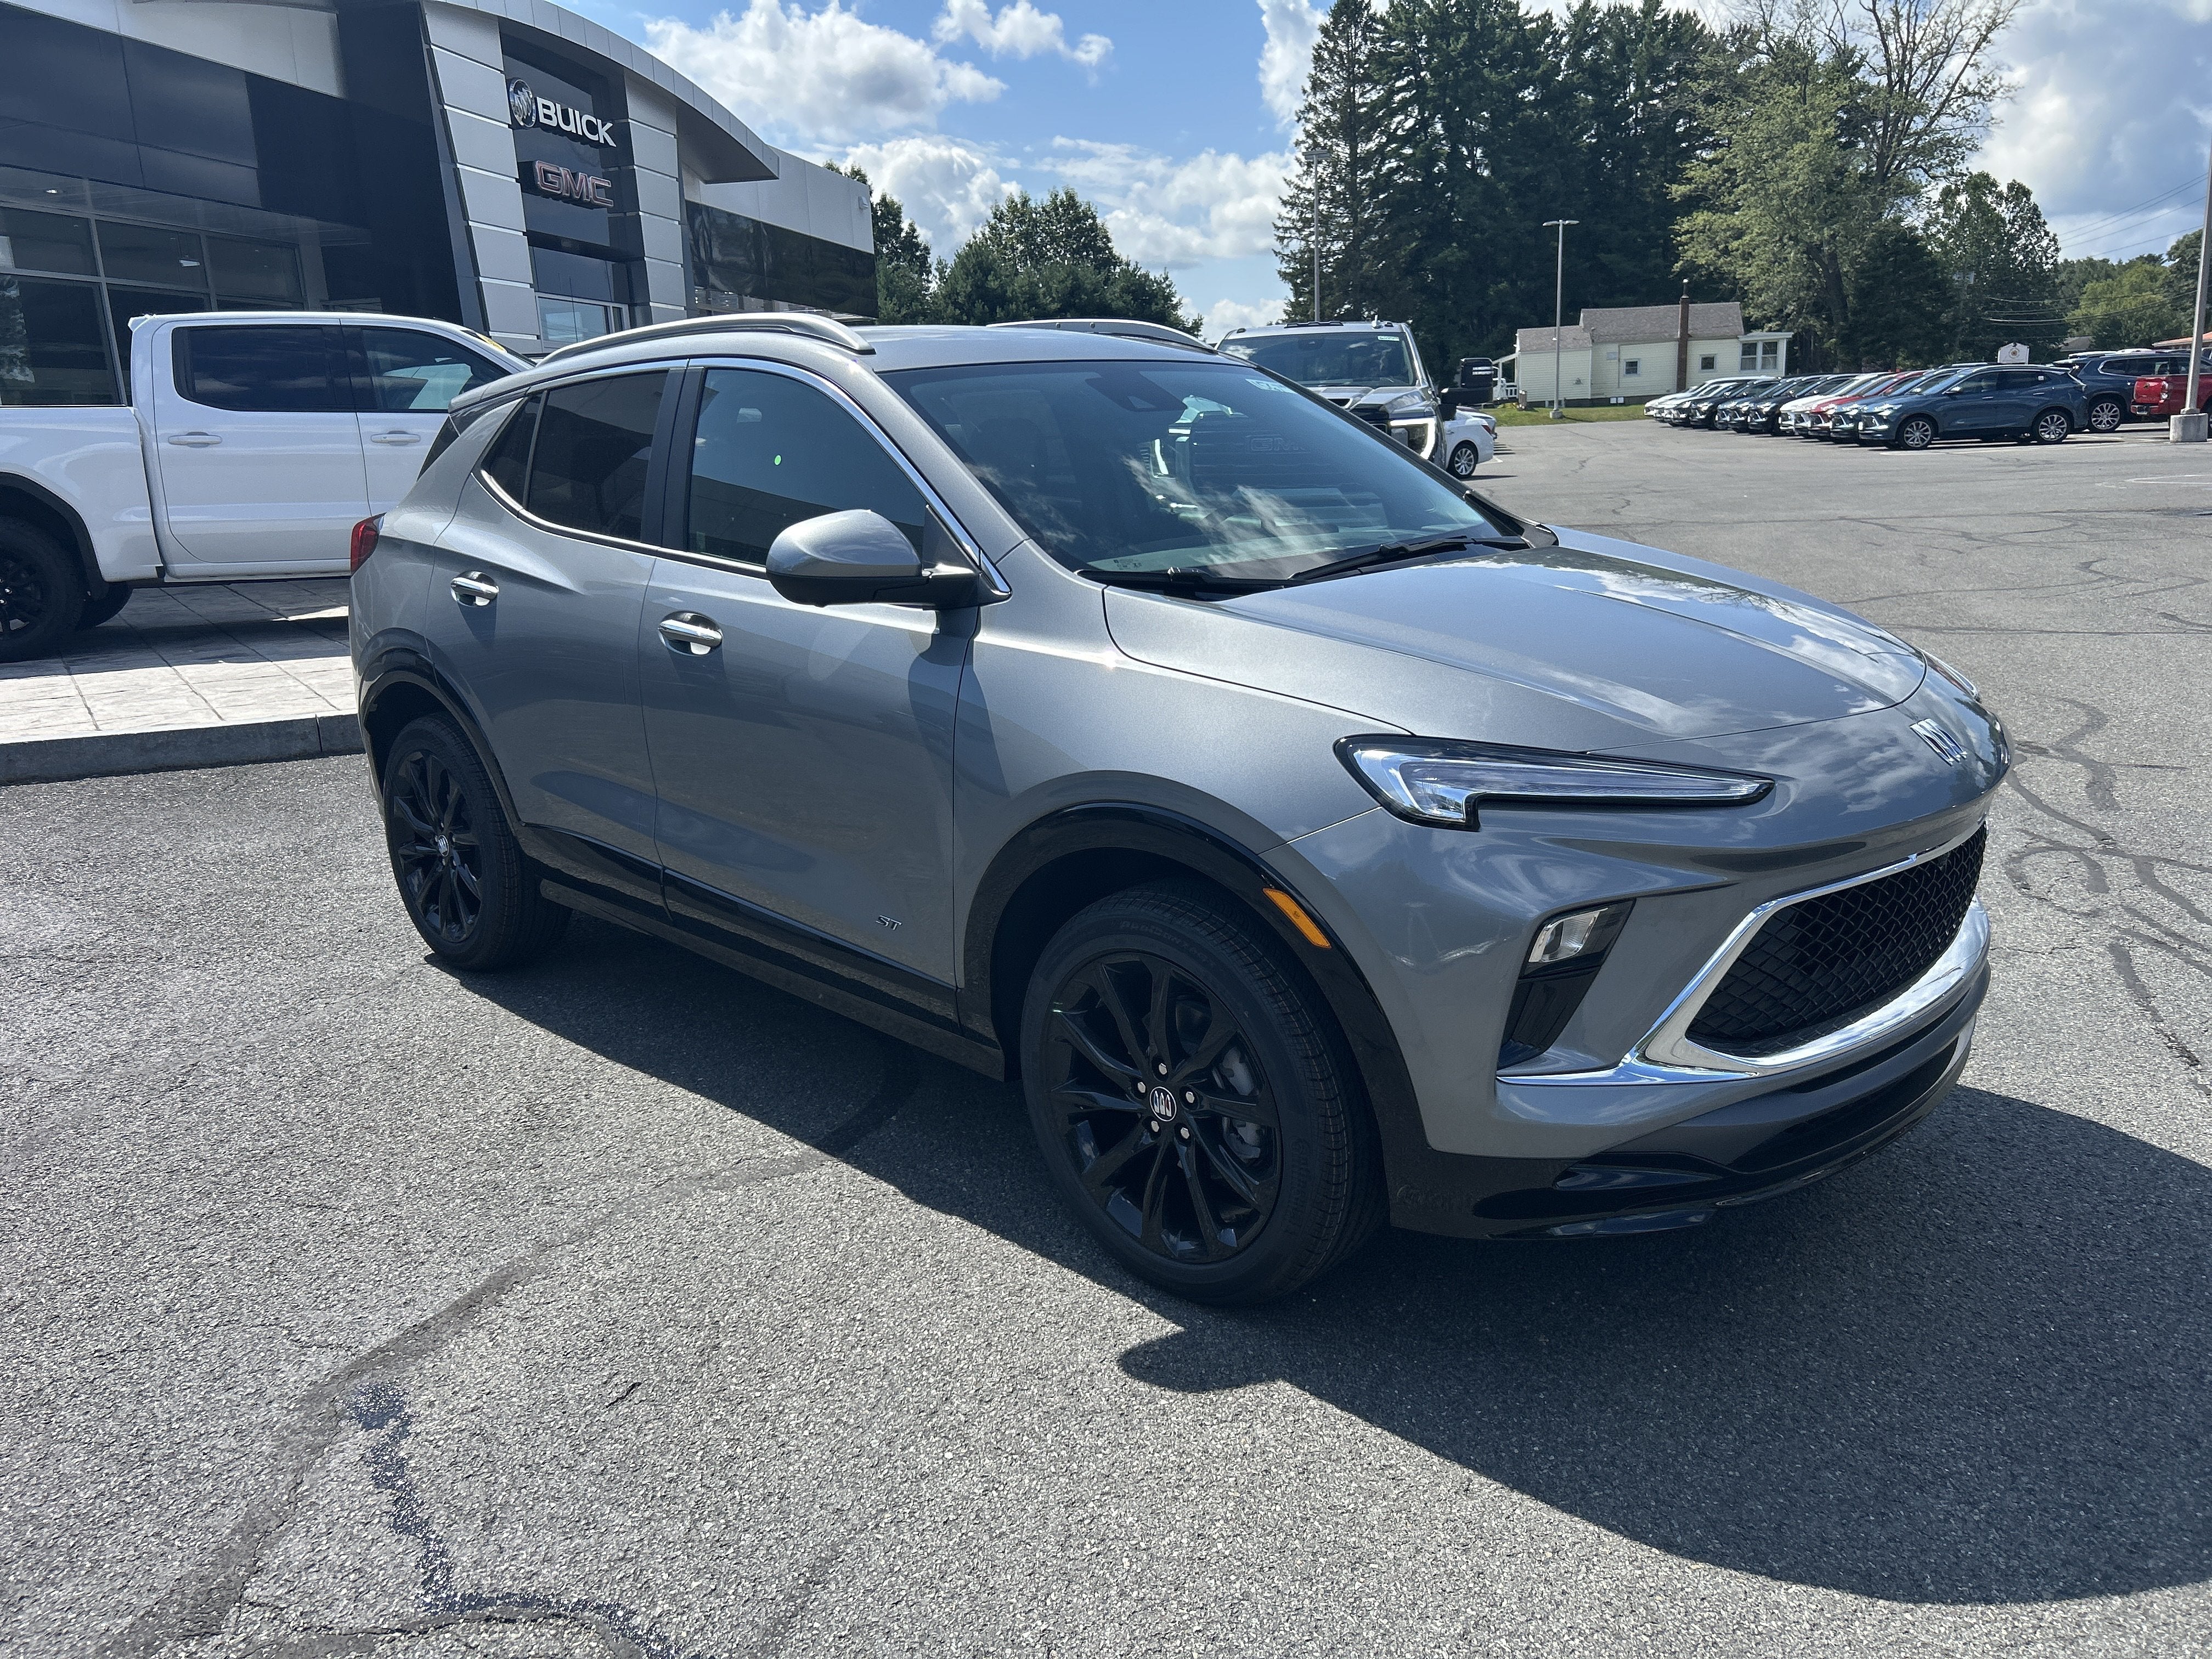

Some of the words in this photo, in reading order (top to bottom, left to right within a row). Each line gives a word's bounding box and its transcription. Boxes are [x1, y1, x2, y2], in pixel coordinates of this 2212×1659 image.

[537, 97, 616, 147] BUICK
[535, 160, 614, 207] GMC
[1251, 438, 1306, 451] GM
[876, 915, 902, 930] ST
